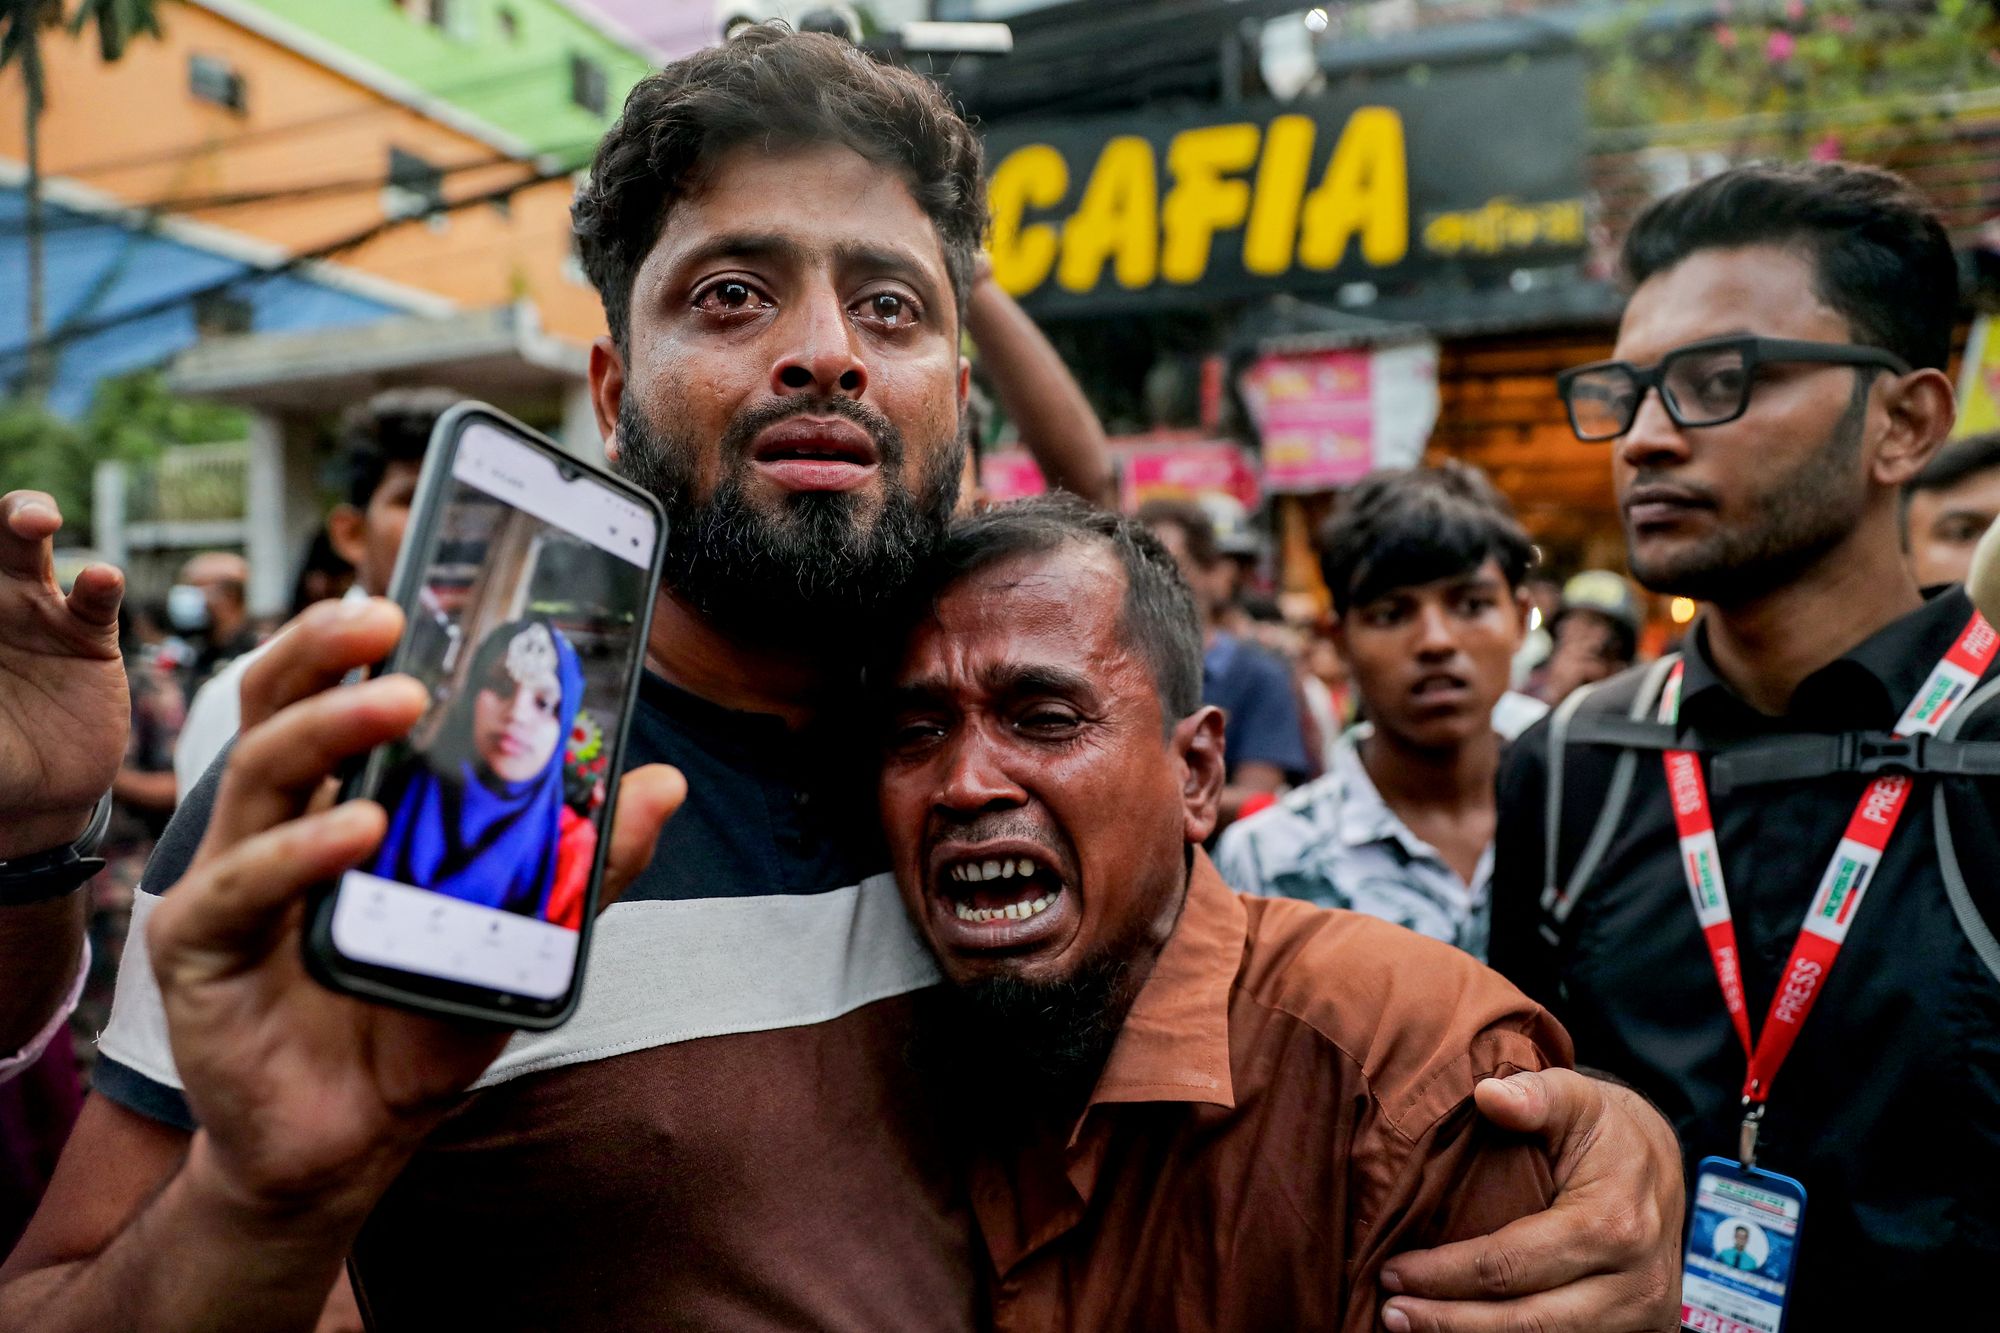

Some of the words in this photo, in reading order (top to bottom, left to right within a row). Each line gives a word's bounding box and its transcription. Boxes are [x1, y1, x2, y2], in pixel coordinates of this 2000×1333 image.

[986, 106, 1408, 297] CAFIA
[1672, 754, 1701, 815] PRESS
[1717, 945, 1742, 1014] PRESS
[1775, 957, 1822, 1024] PRESS
